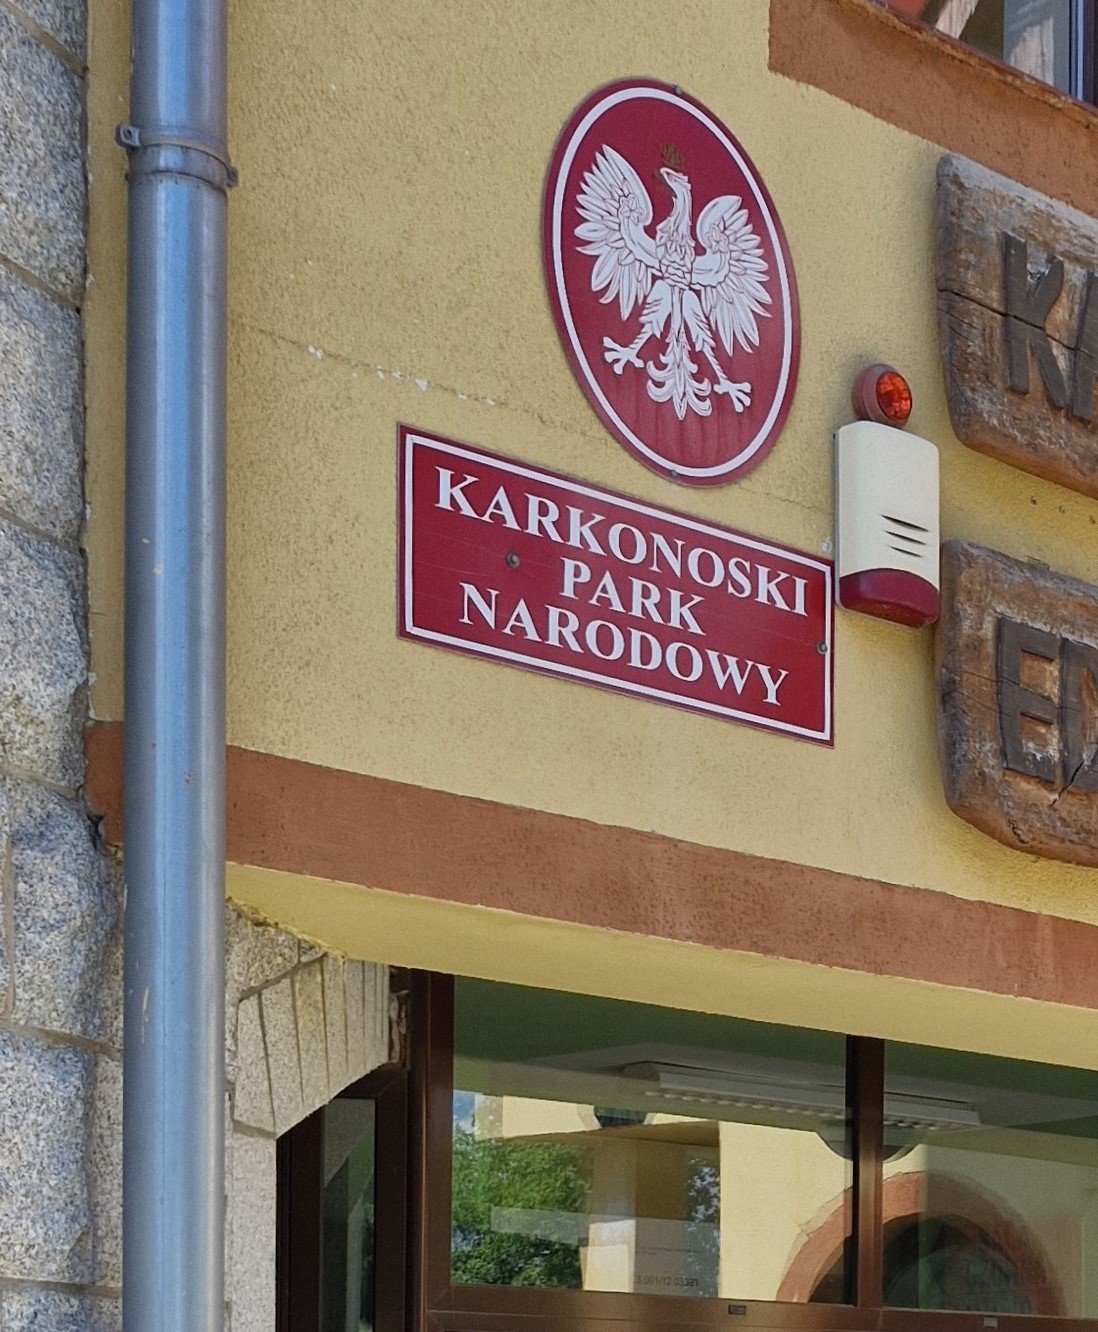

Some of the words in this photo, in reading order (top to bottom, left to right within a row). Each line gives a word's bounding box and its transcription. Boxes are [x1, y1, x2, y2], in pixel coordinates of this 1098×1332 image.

[434, 466, 809, 617] KARKONOSKI
[560, 557, 705, 636] PARK
[459, 582, 789, 706] NARODOWY
